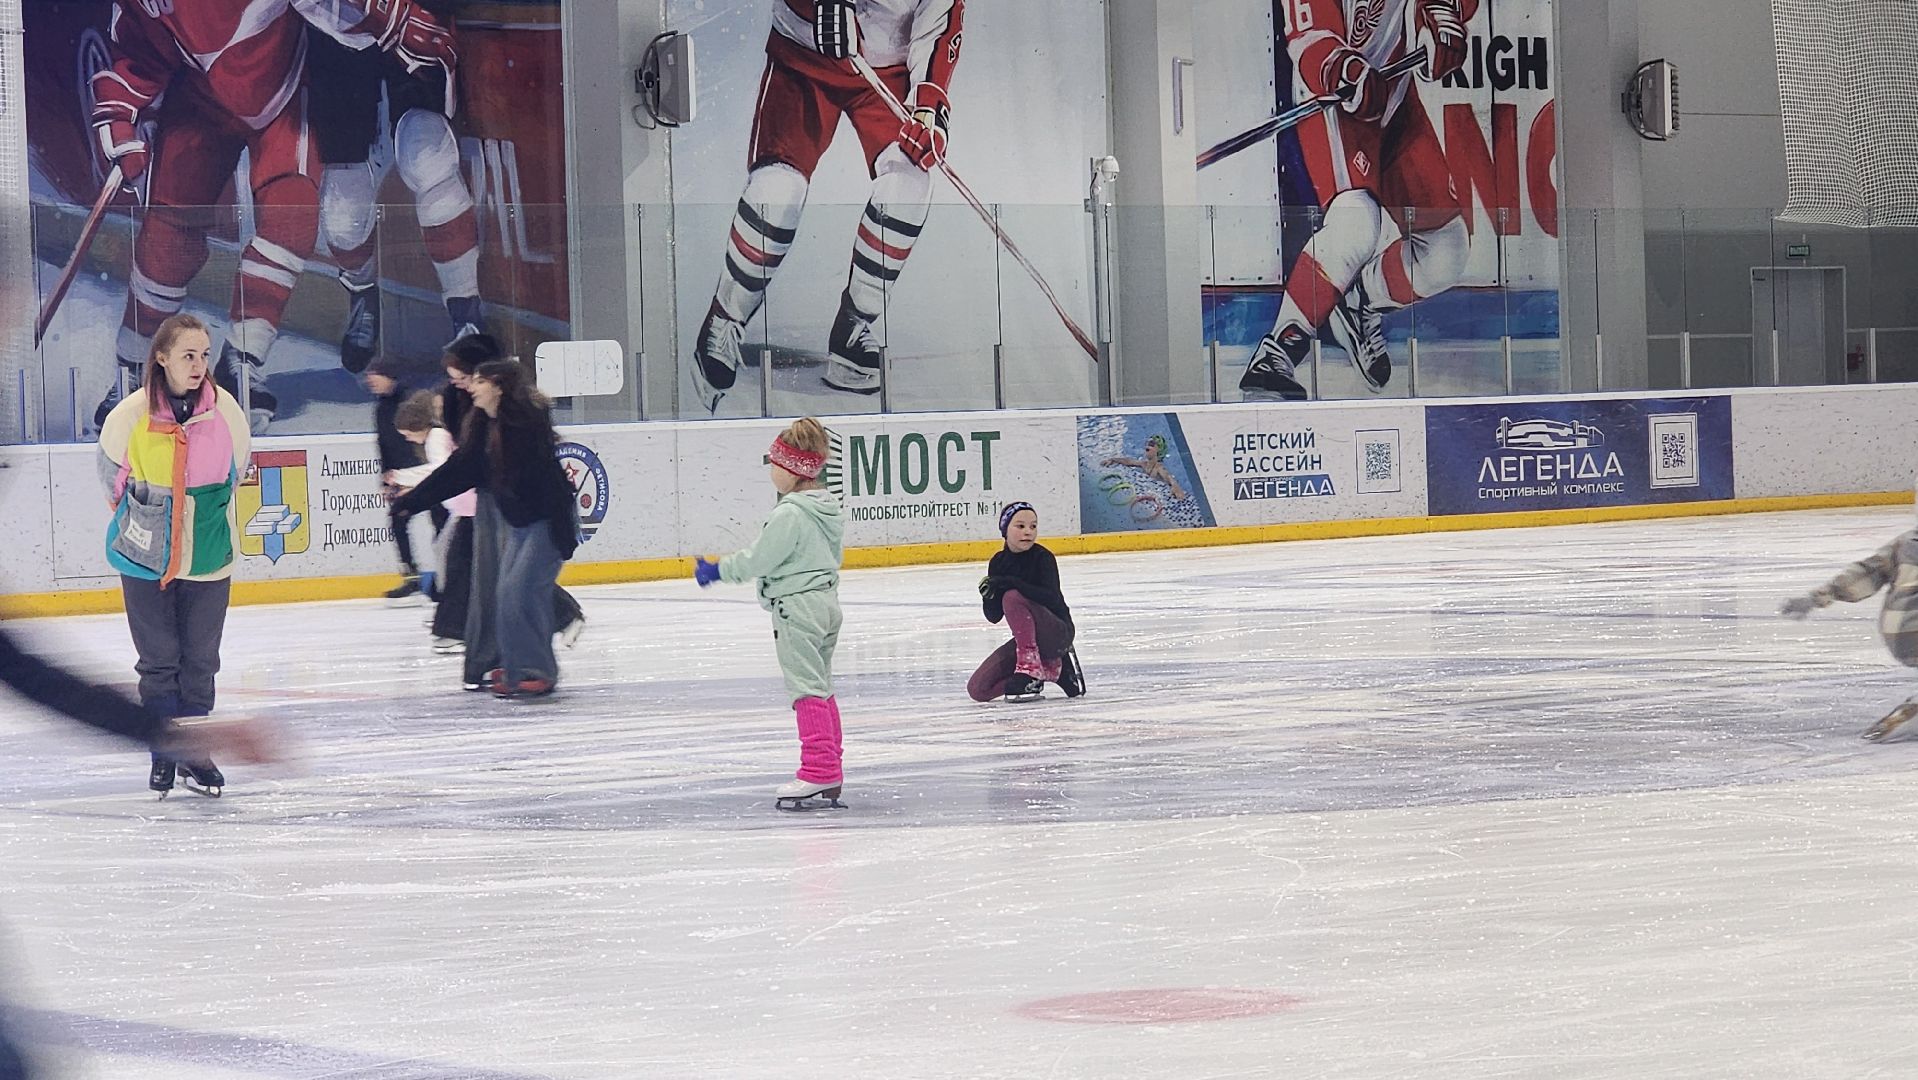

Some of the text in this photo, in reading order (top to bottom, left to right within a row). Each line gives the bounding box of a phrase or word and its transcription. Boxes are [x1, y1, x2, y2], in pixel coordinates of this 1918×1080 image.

[1232, 427, 1316, 455] ДЕТСКИЙ
[320, 453, 383, 480] Админис
[850, 431, 1001, 497] МОСТ
[1232, 449, 1322, 474] БАССЕЙН
[1477, 452, 1625, 483] ЛЕГЕНДА
[321, 488, 394, 516] Городског
[1236, 479, 1334, 499] ЛЕГЕНДА
[1478, 481, 1625, 501] Спортивный комплекс
[851, 500, 971, 521] МОСОБЛСТРОЙТРЕСТ
[977, 501, 989, 516] №
[323, 523, 396, 551] Домодедов
